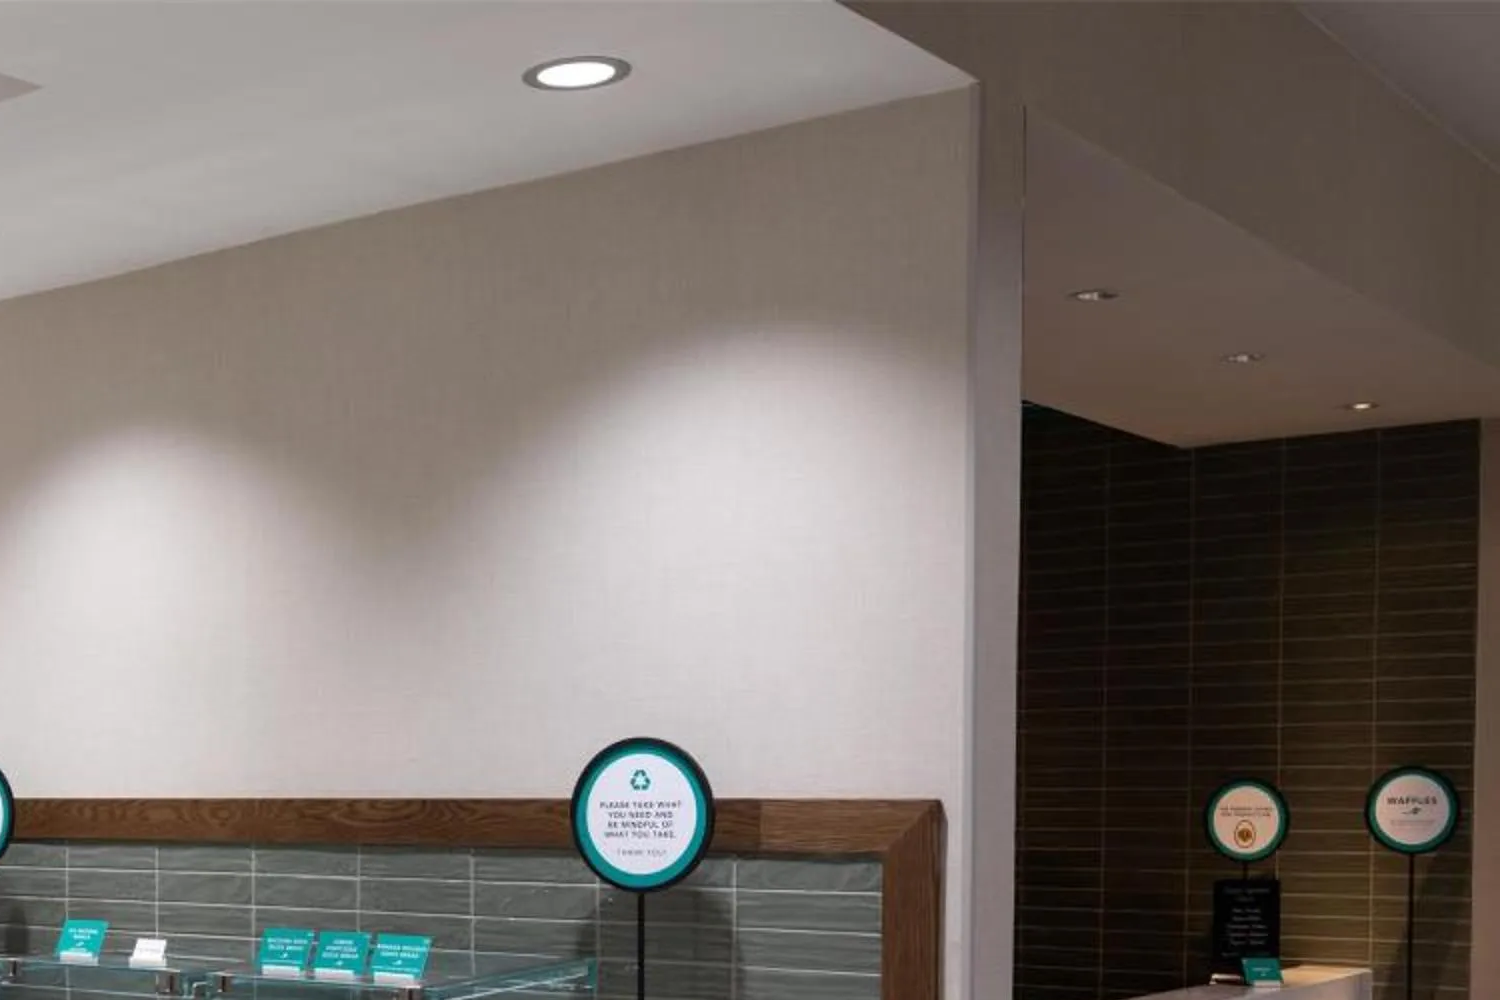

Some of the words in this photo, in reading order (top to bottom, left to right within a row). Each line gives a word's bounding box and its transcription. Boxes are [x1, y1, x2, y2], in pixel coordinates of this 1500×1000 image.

[657, 800, 681, 808] WHAT
[621, 821, 660, 829] MINDFUL
[661, 820, 674, 829] OF
[631, 831, 650, 839] YOU
